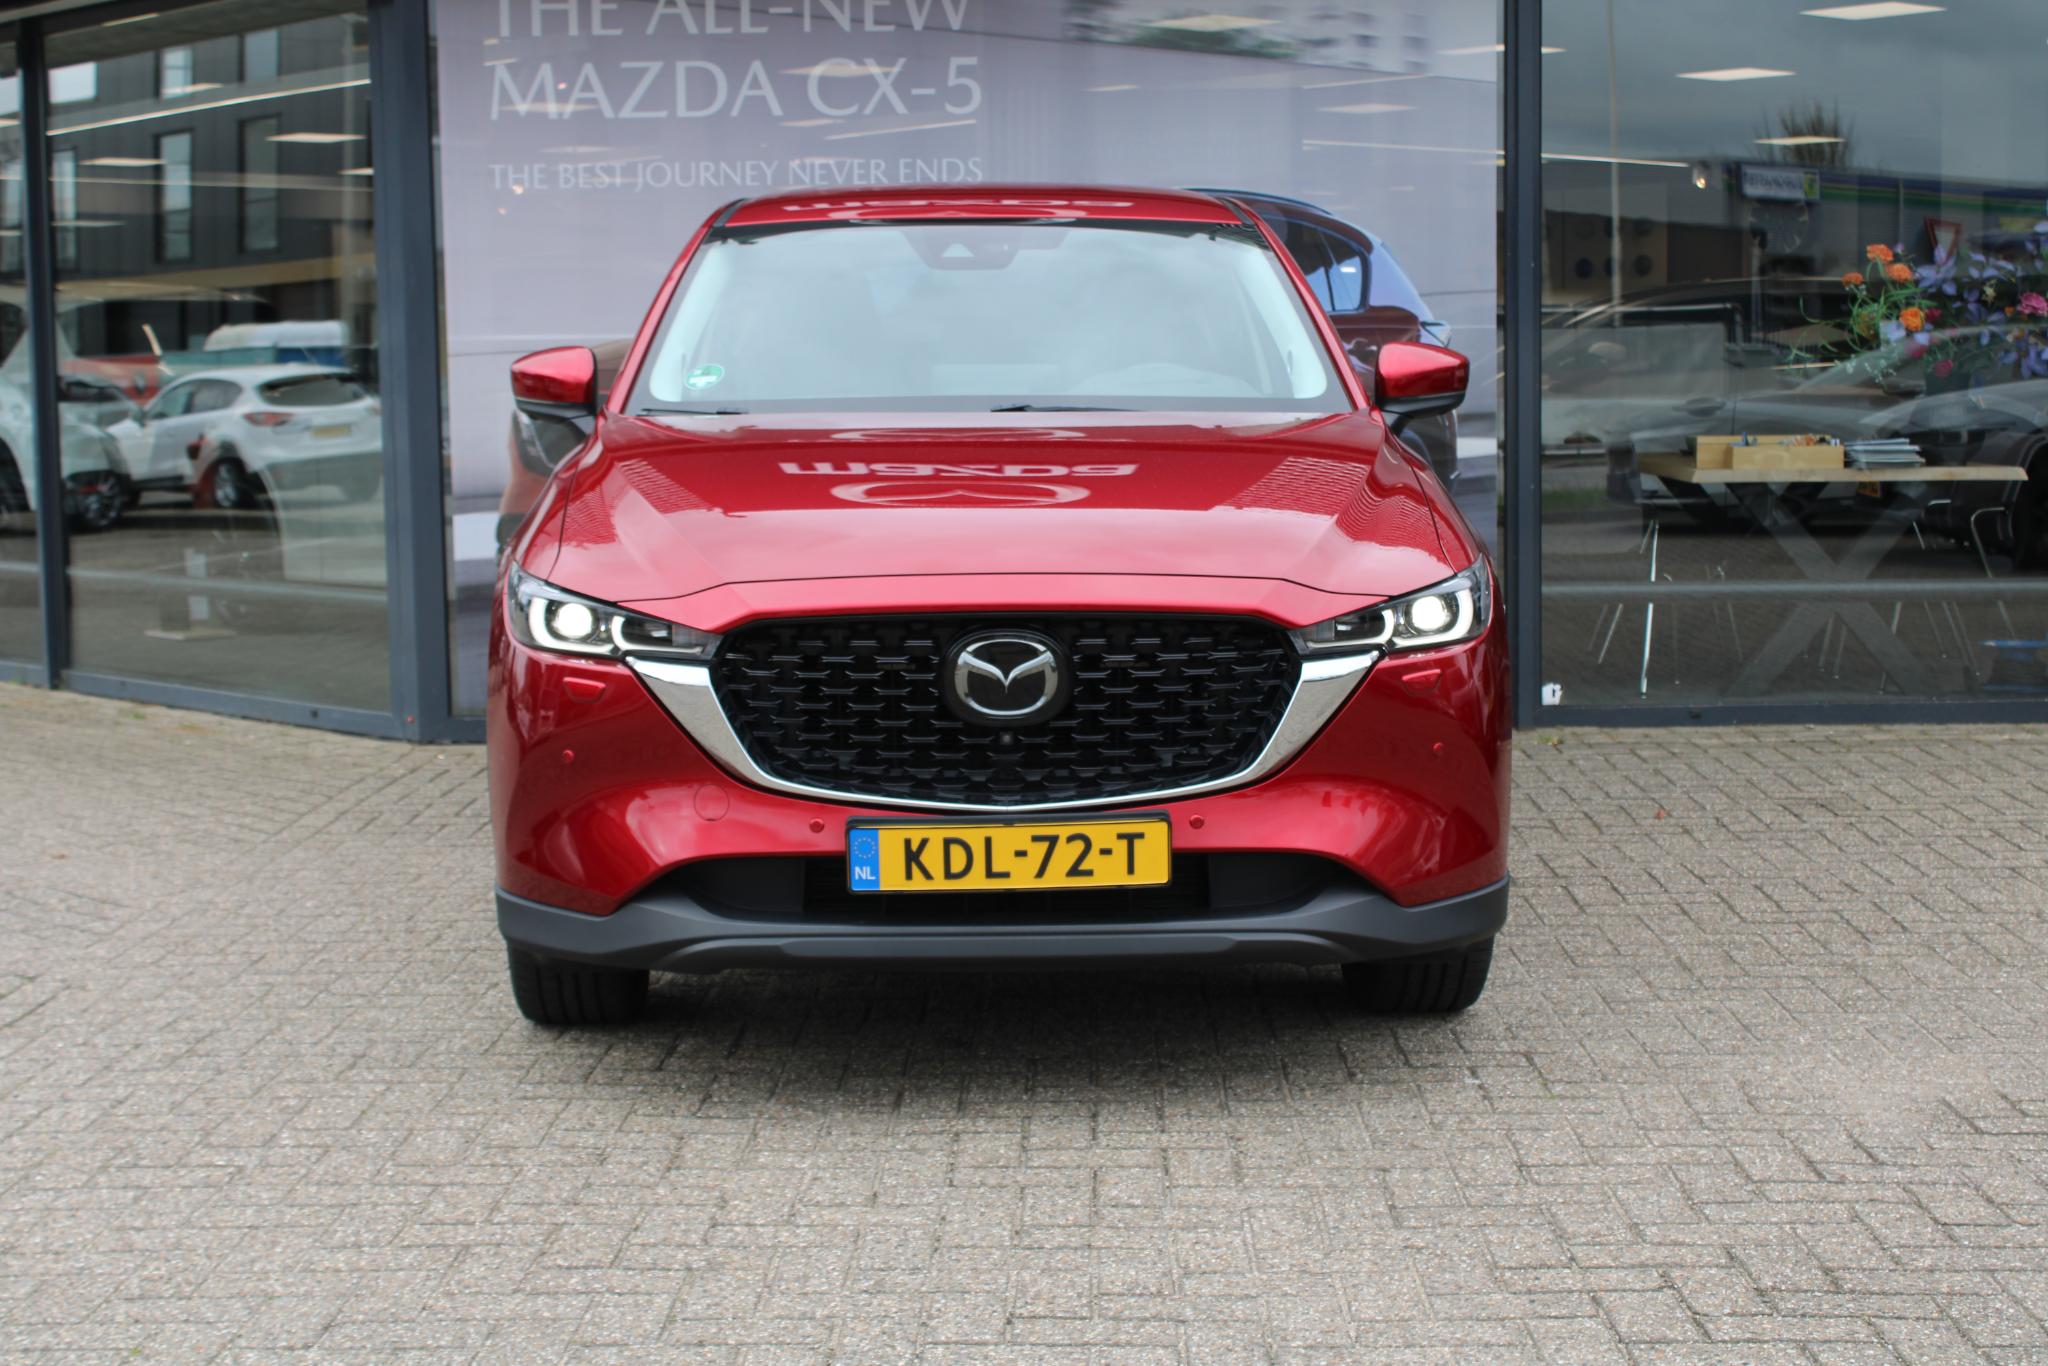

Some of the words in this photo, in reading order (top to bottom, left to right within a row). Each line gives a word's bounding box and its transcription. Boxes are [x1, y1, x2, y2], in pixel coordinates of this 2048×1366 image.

[646, 0, 967, 34] ALL-NEW
[489, 61, 784, 120] MAZDA
[807, 56, 982, 116] CX-5
[488, 163, 548, 190] THE
[558, 162, 624, 189] BEST
[634, 160, 779, 192] JOURNEY
[788, 158, 889, 187] NEVER
[900, 157, 983, 184] ENDS
[855, 866, 876, 881] NL
[903, 832, 1145, 881] KDL-72-T
